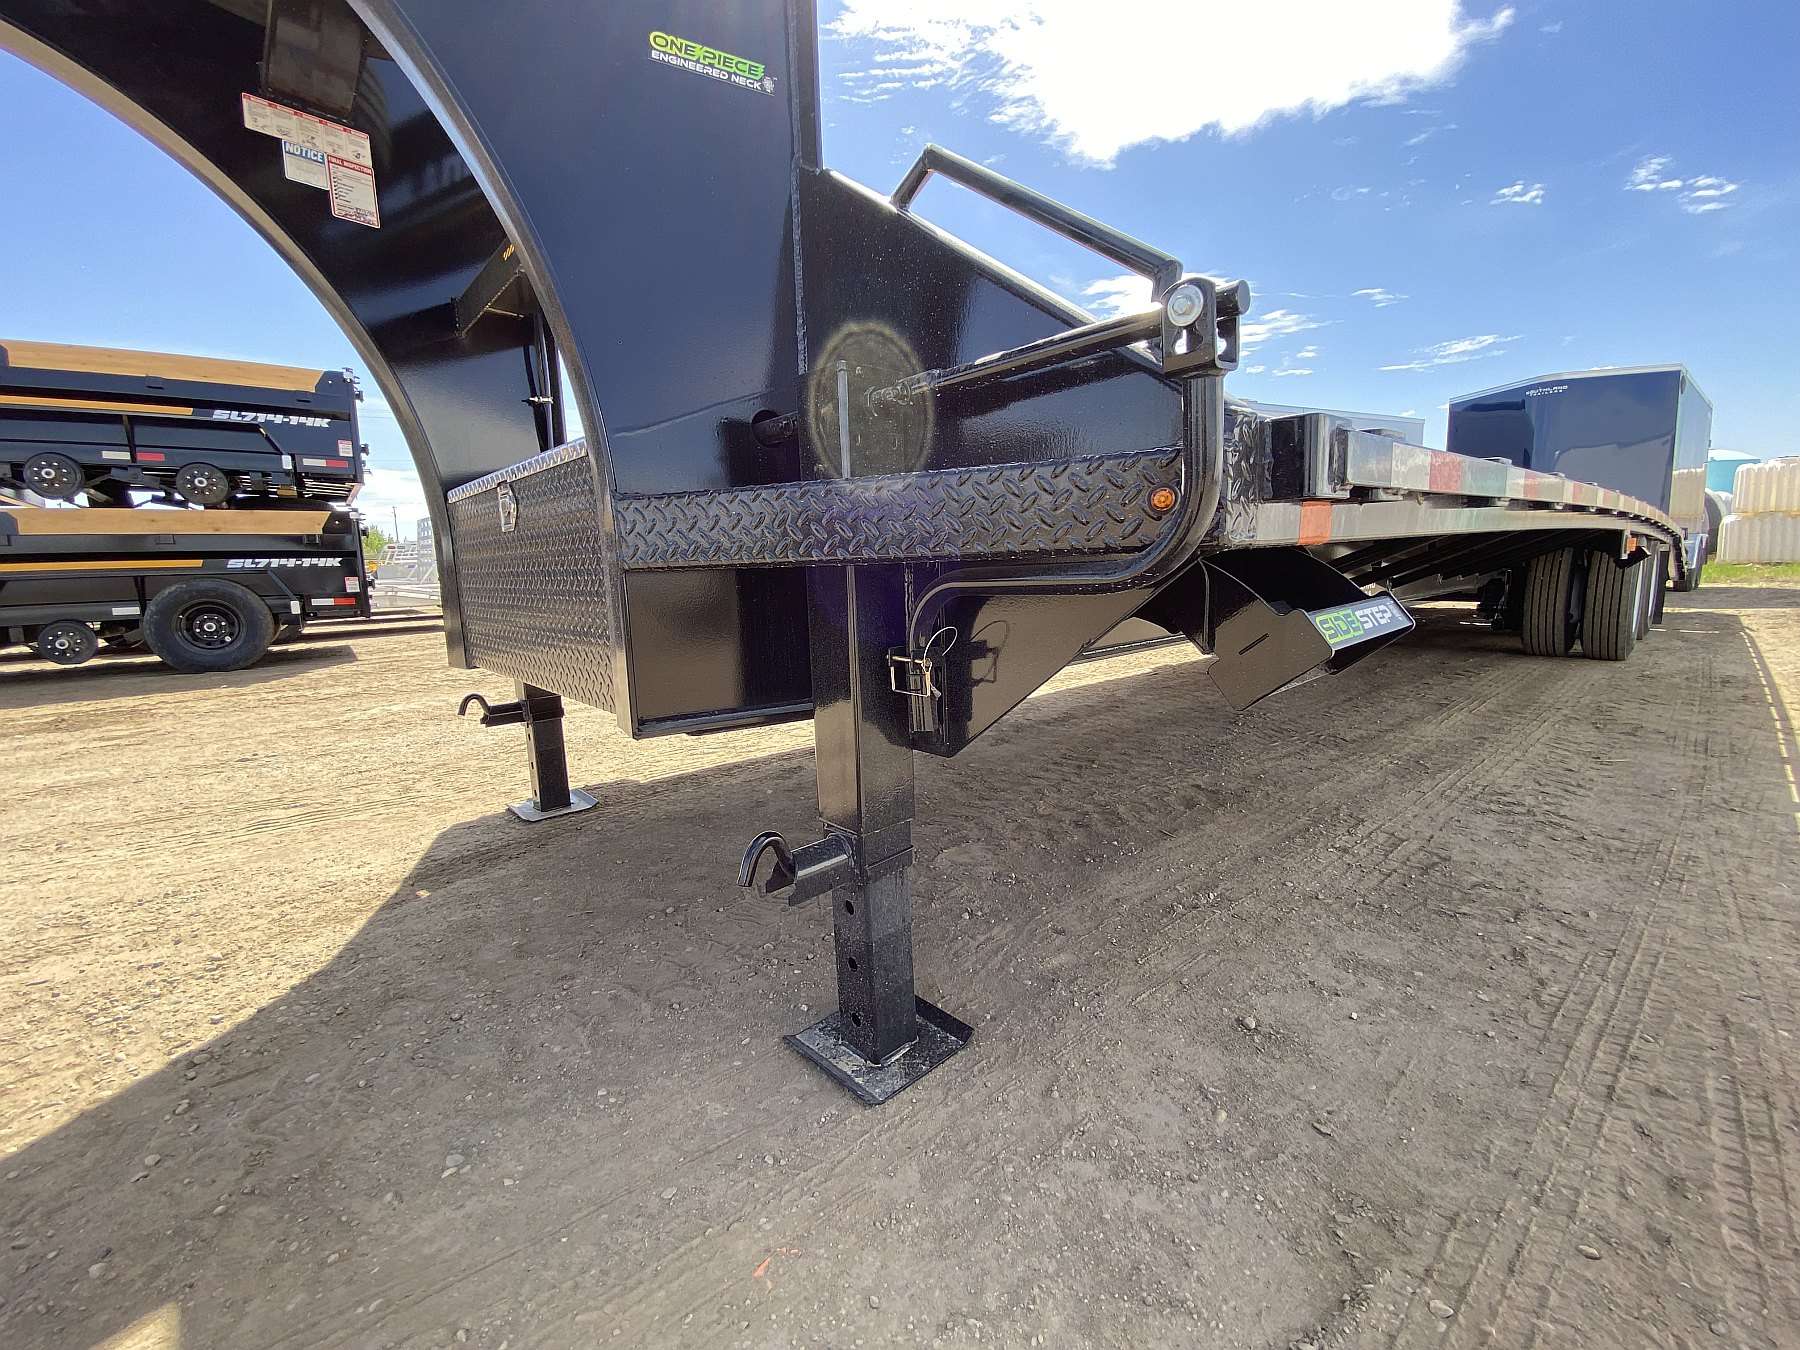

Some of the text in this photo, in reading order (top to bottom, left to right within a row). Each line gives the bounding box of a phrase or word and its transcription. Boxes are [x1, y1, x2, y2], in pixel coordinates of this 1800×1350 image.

[649, 31, 765, 80] ONE PIECE
[651, 49, 762, 90] ENGINEERED NECK
[285, 142, 325, 163] NOTICE
[212, 409, 331, 428] SL714-14K
[226, 557, 343, 568] SL714-14K
[1355, 604, 1393, 630] STEP
